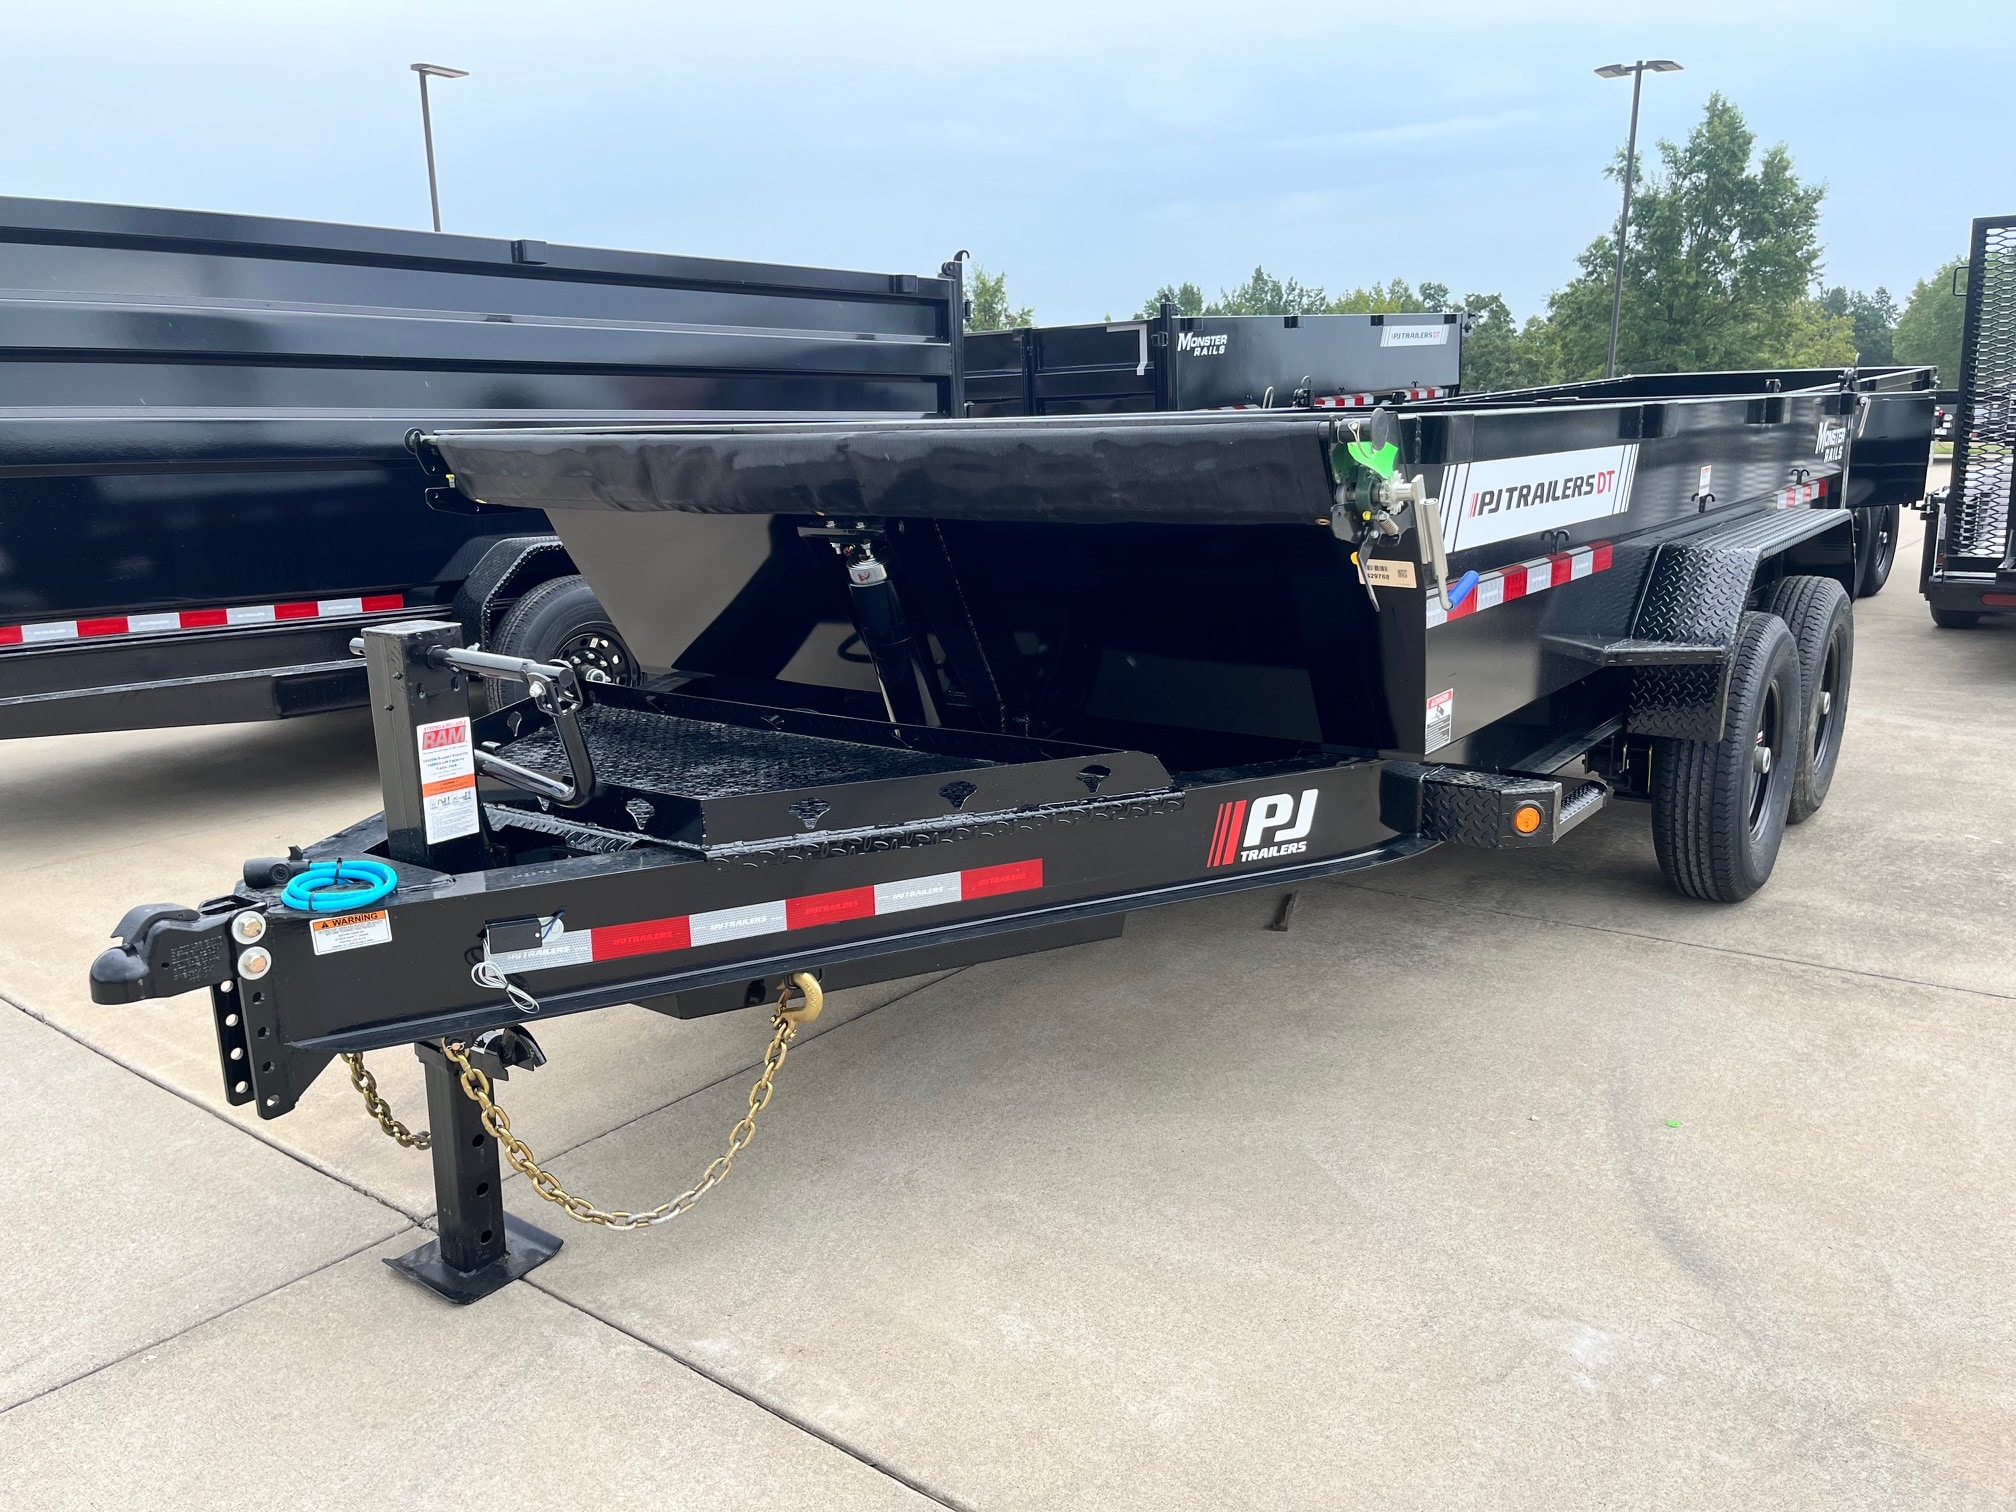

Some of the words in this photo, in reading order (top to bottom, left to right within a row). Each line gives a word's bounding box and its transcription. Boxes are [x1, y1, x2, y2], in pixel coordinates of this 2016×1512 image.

[1194, 345, 1226, 357] RAILS
[1824, 445, 1843, 464] RAILS
[1596, 469, 1616, 495] DT
[422, 725, 467, 750] RAM
[1242, 788, 1319, 848] PJ
[1240, 841, 1307, 863] TRAILERS
[332, 912, 378, 927] WARNING
